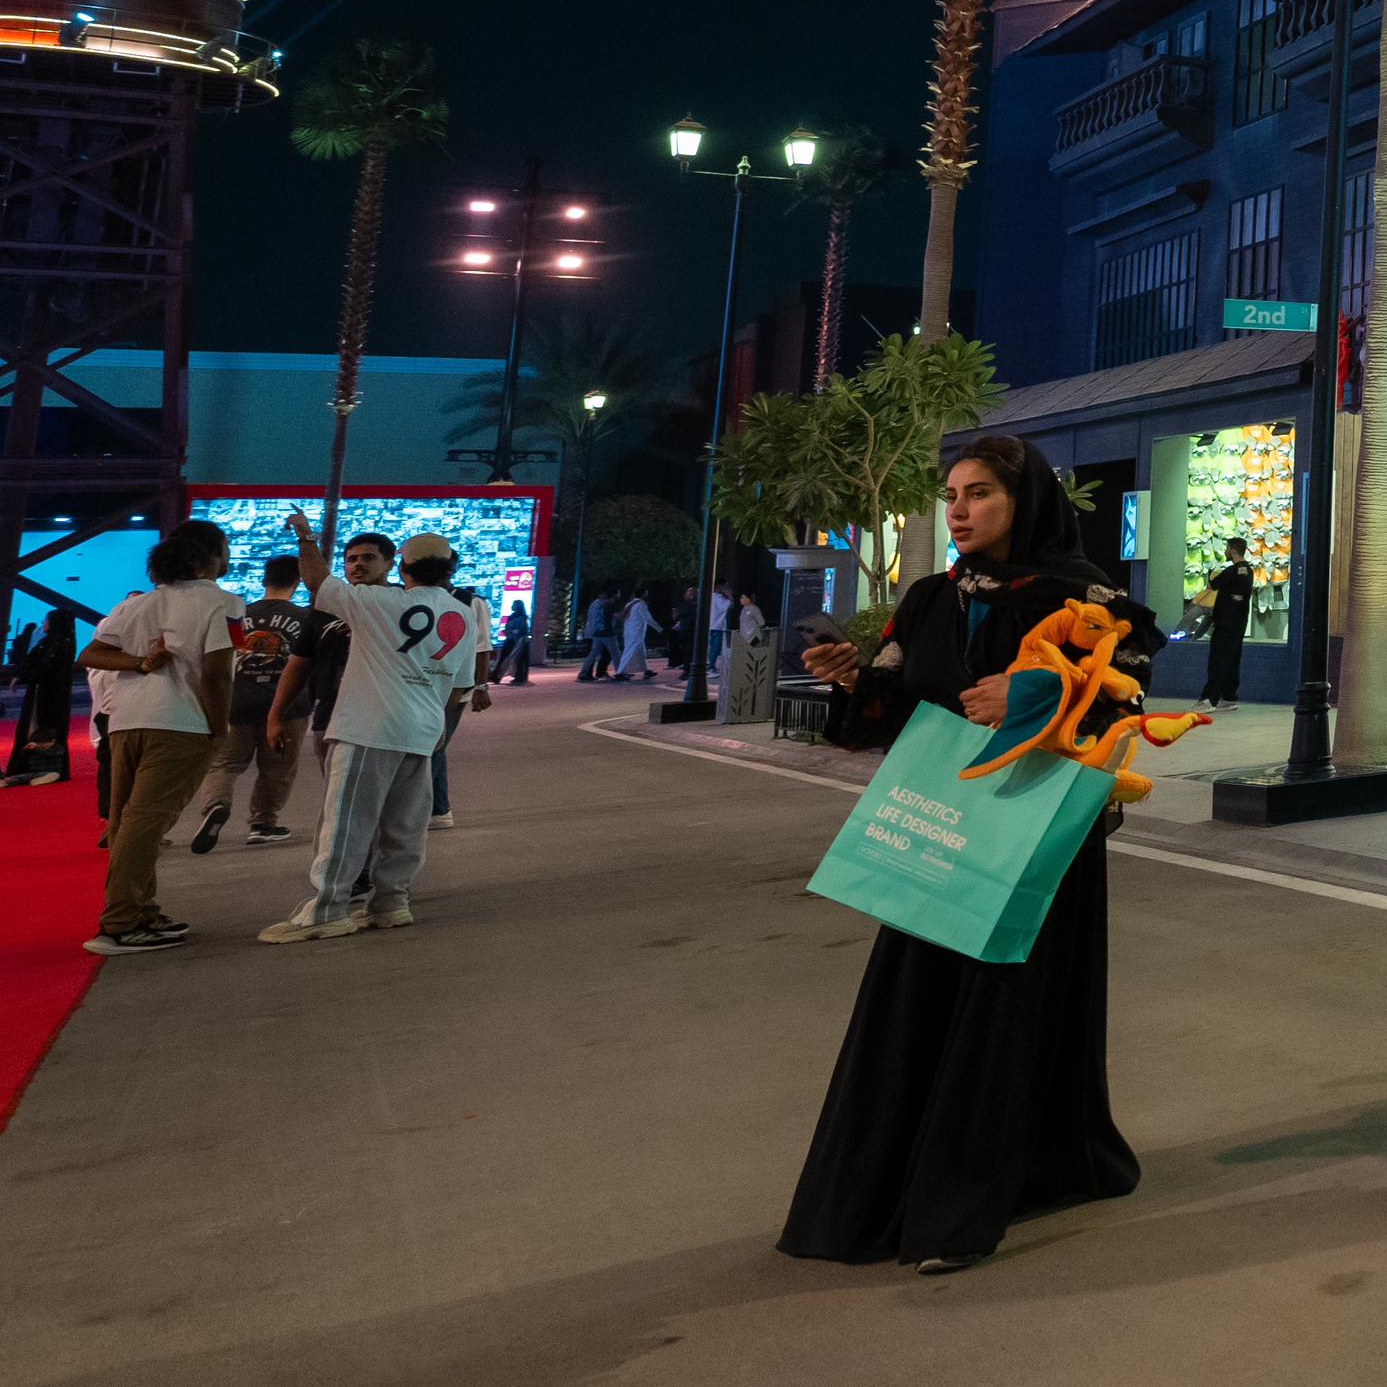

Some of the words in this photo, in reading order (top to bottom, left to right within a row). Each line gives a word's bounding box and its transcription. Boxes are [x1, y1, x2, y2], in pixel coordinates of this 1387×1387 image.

[1243, 304, 1286, 325] 2nd
[887, 785, 962, 826] AESTHETICS
[864, 822, 912, 851] BRAND
[875, 803, 903, 824] LIFE
[900, 813, 968, 852] DESIGNER
